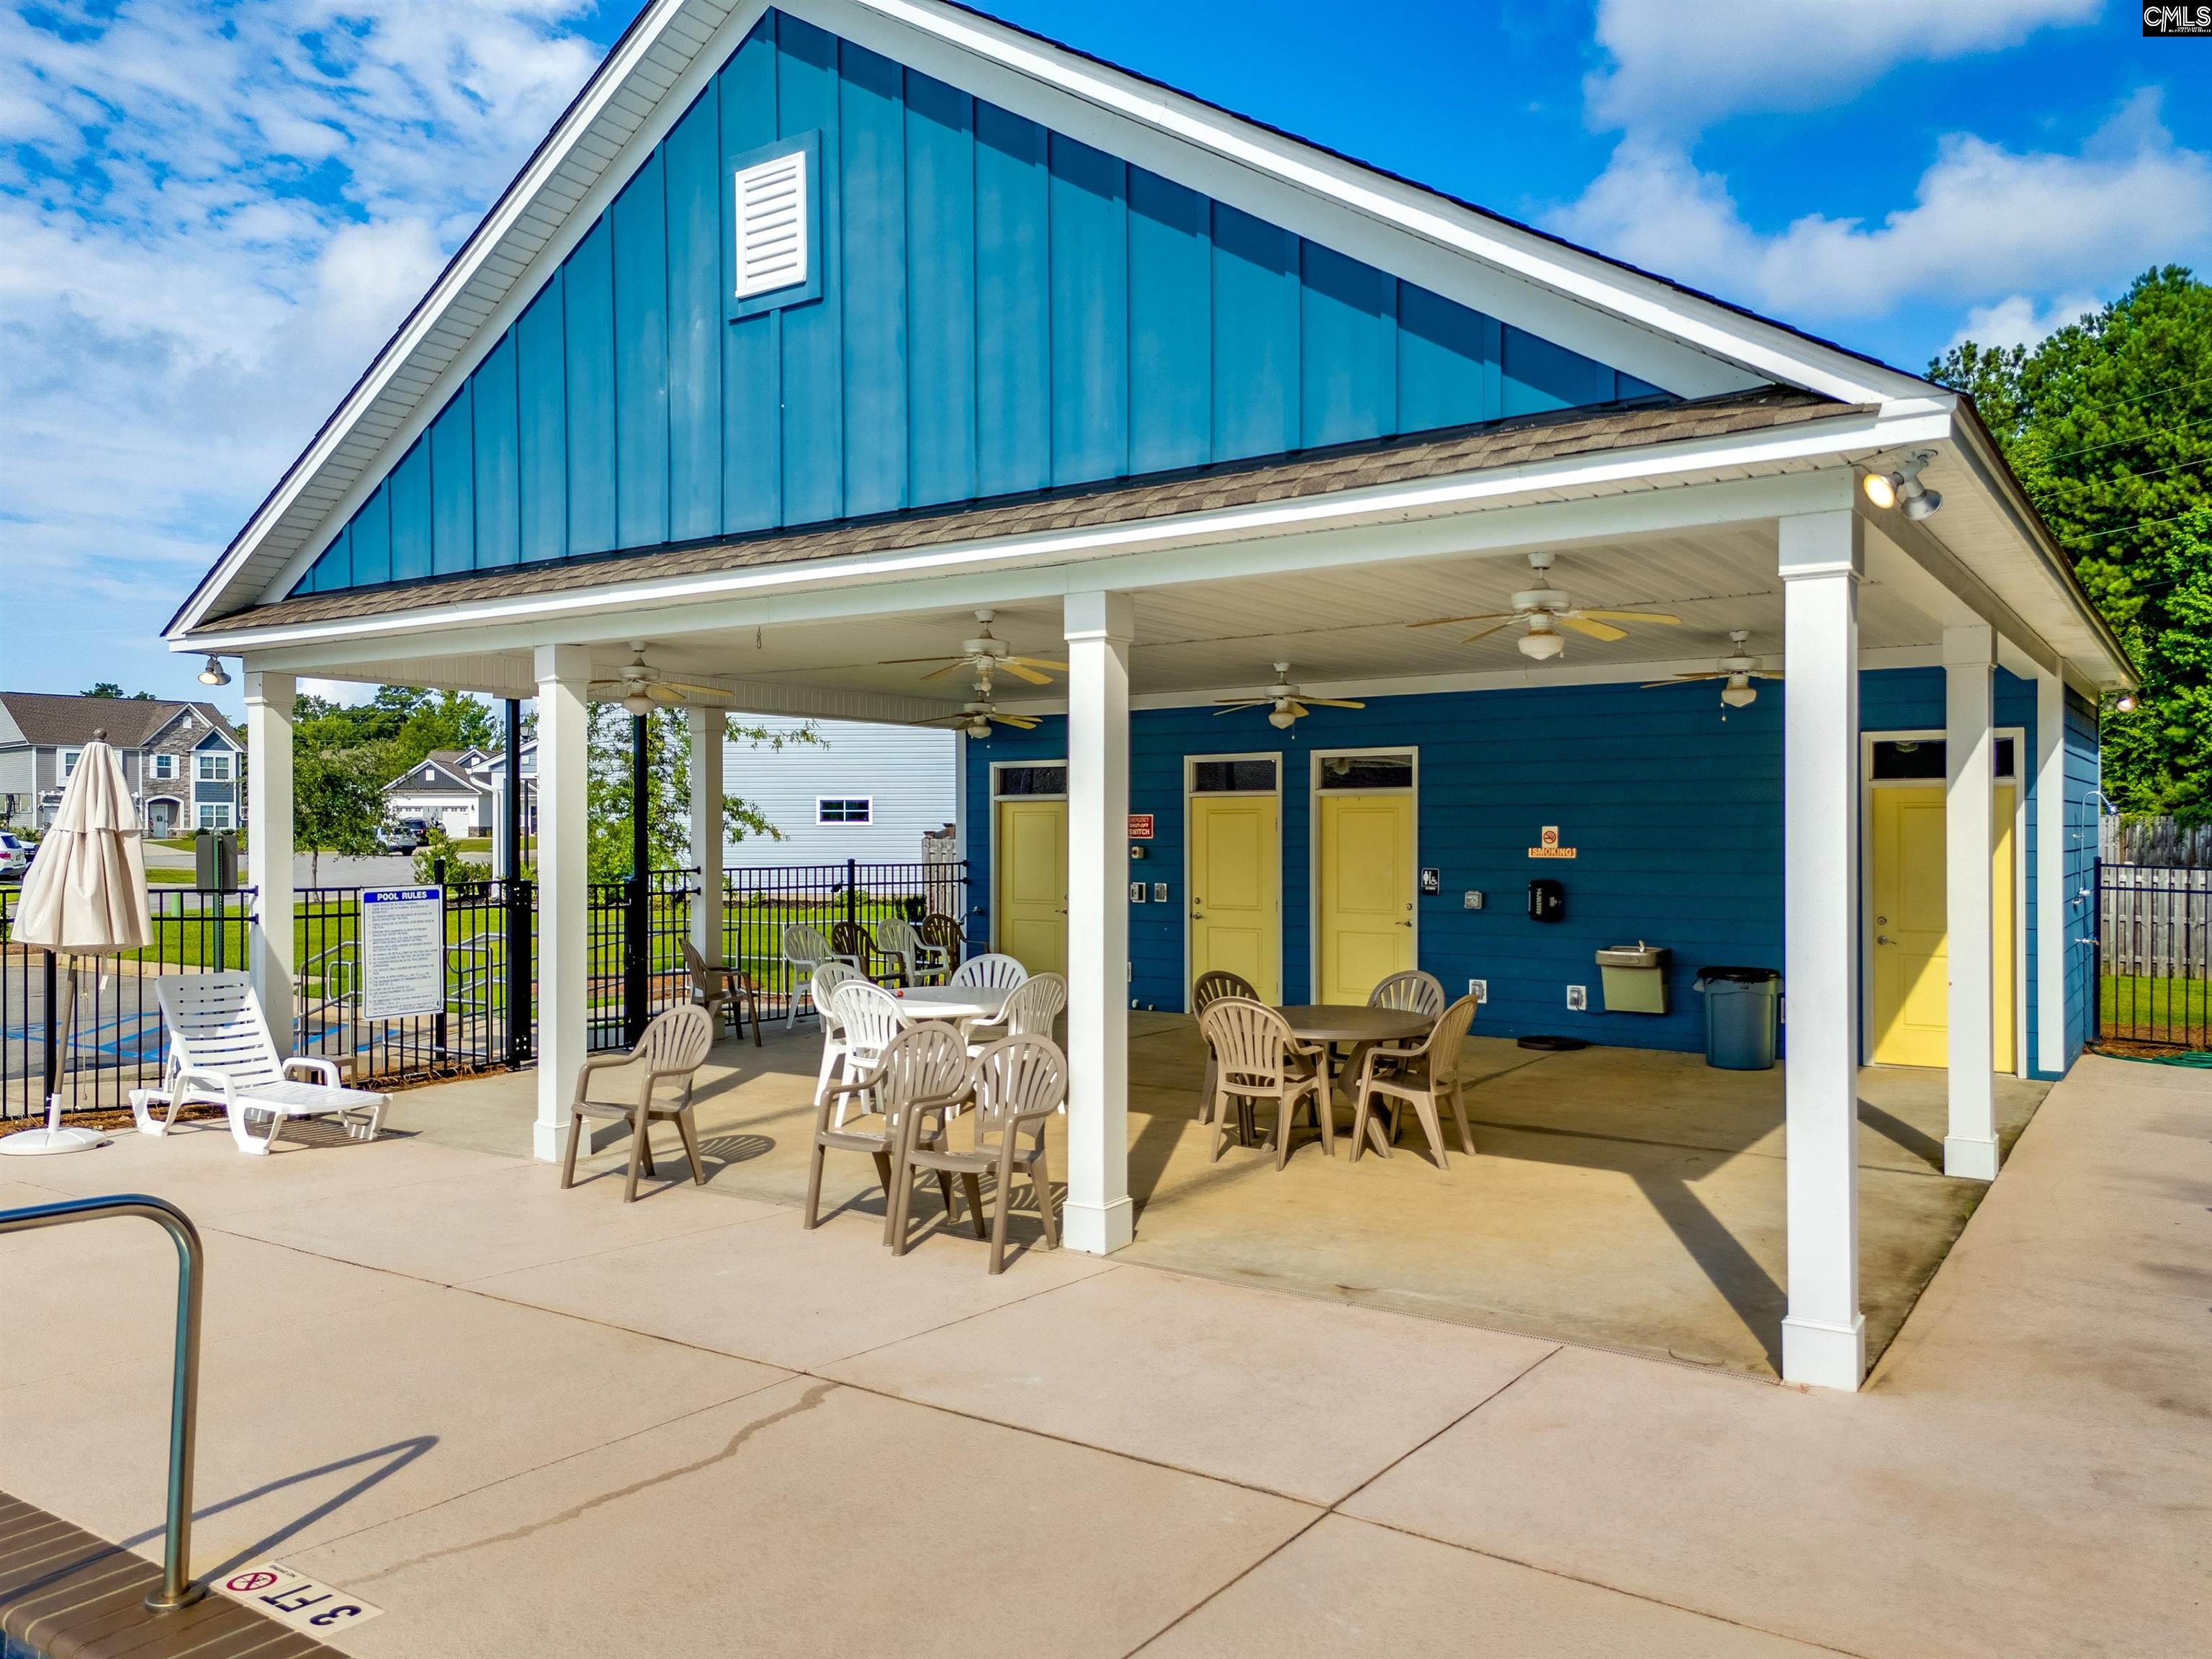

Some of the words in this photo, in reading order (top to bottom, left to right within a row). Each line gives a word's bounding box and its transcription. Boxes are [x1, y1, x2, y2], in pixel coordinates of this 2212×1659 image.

[402, 891, 427, 899] RULES
[258, 1584, 333, 1612] FT
[310, 1605, 361, 1626] 3
